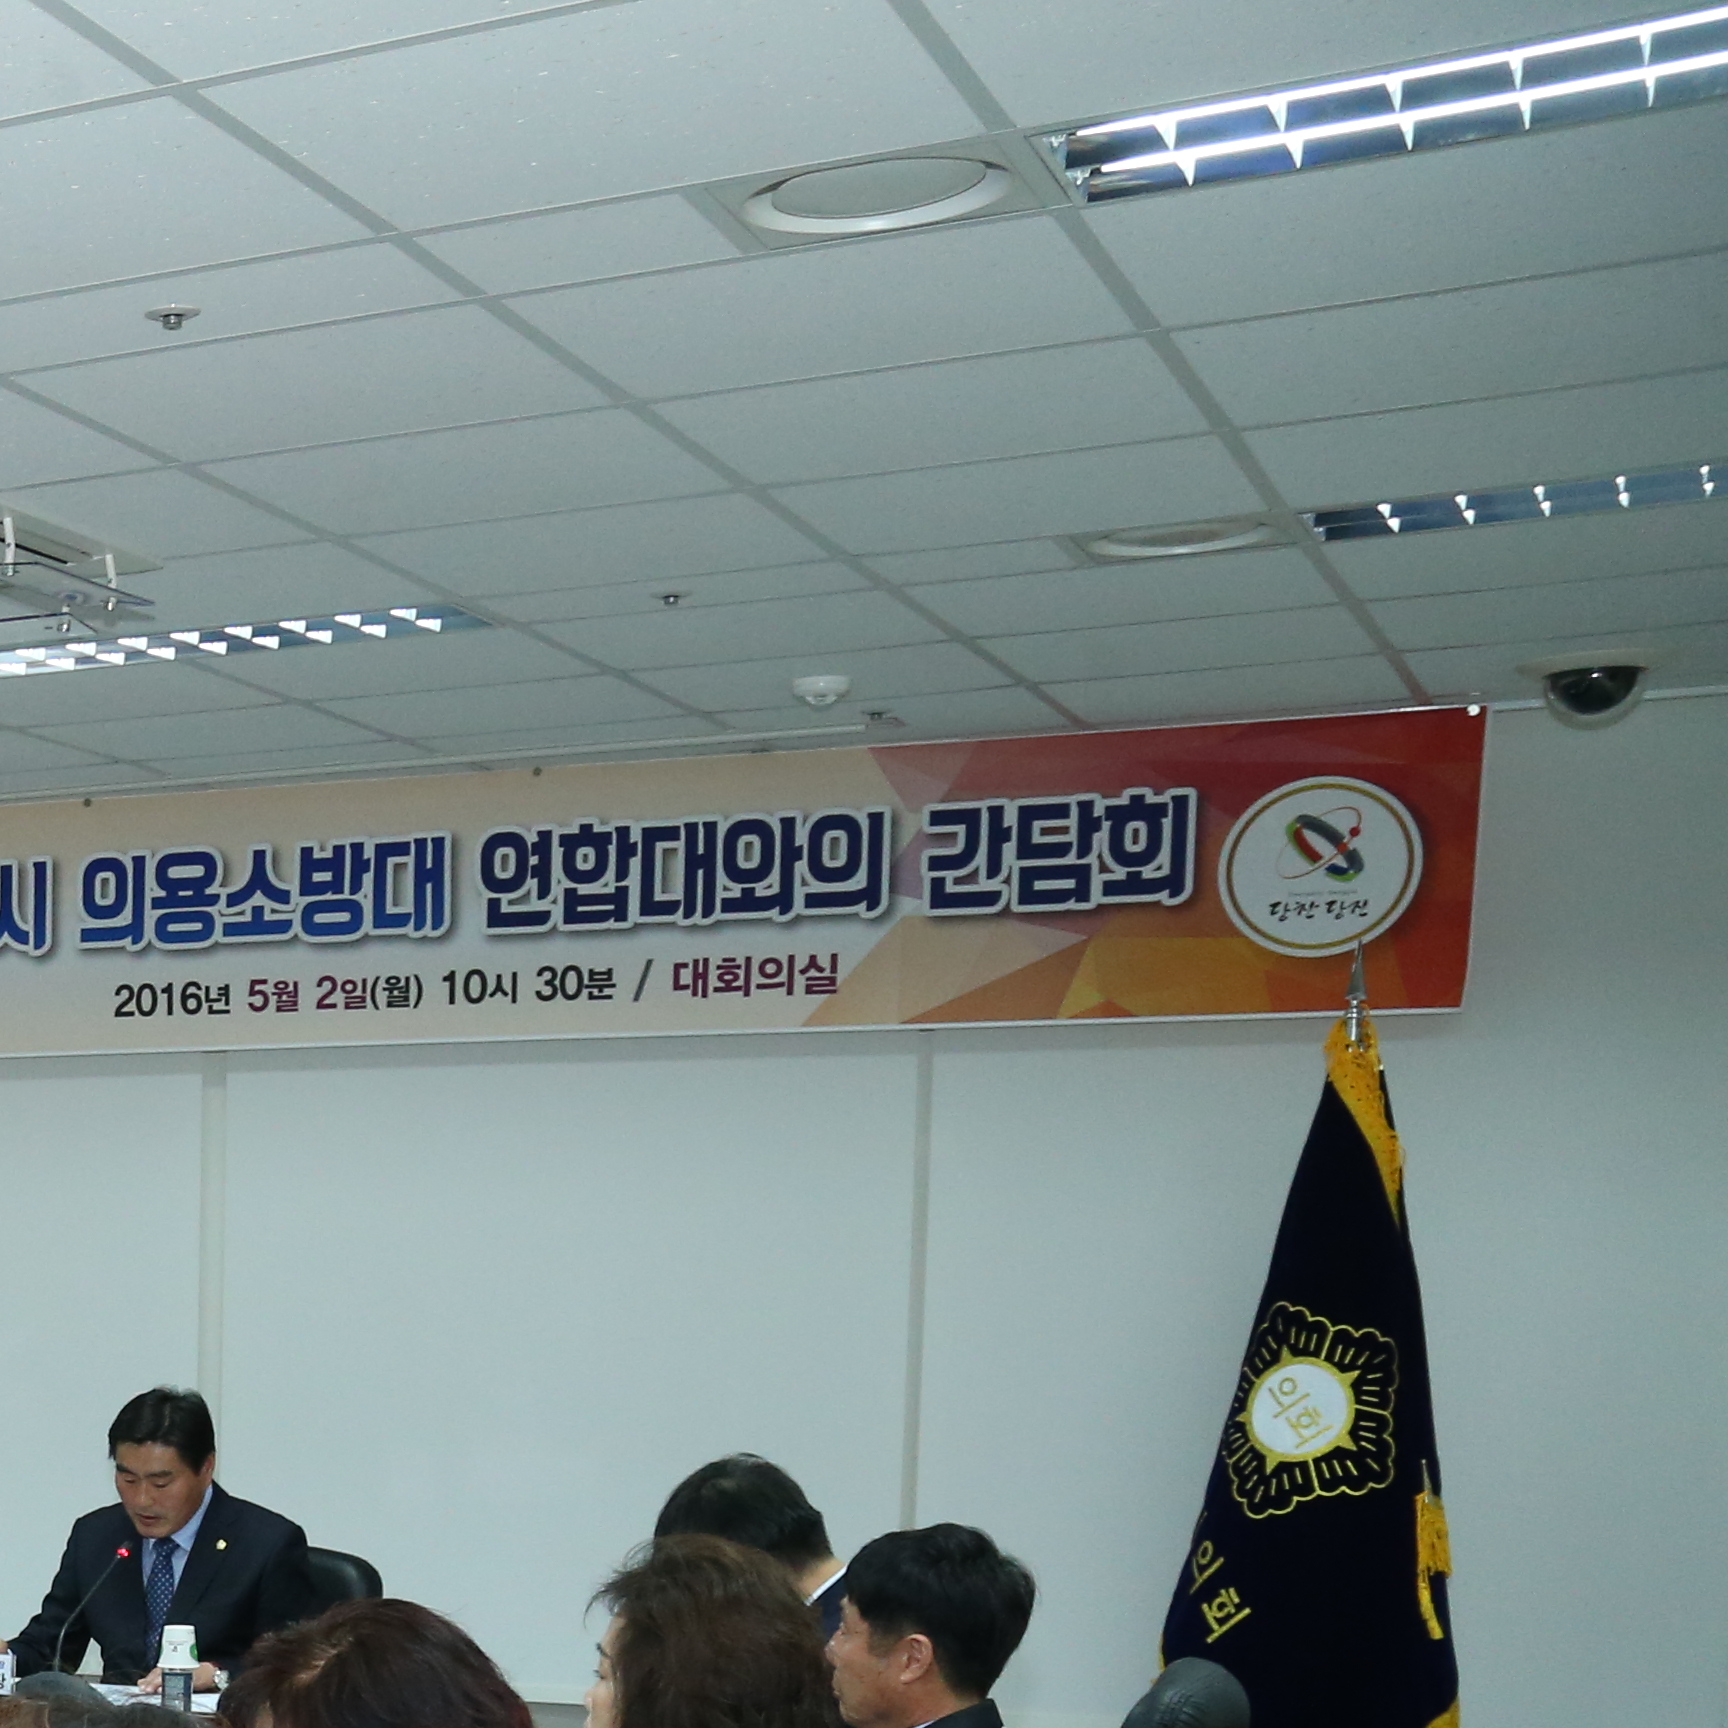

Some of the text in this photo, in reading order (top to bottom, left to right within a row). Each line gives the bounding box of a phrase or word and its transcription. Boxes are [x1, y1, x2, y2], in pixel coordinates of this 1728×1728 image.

[78, 833, 451, 950] 의용소방대
[479, 808, 888, 930] 연합대와의
[924, 790, 1194, 911] 간담회
[1268, 899, 1369, 922] 당찬 당진
[113, 981, 232, 1018] 2016년
[247, 978, 300, 1013] 5월
[315, 973, 424, 1012] 2일(월)
[441, 969, 519, 1006] 10시
[534, 964, 617, 1002] 30분
[672, 952, 840, 999] 대회의실
[1268, 1377, 1334, 1449] 의회
